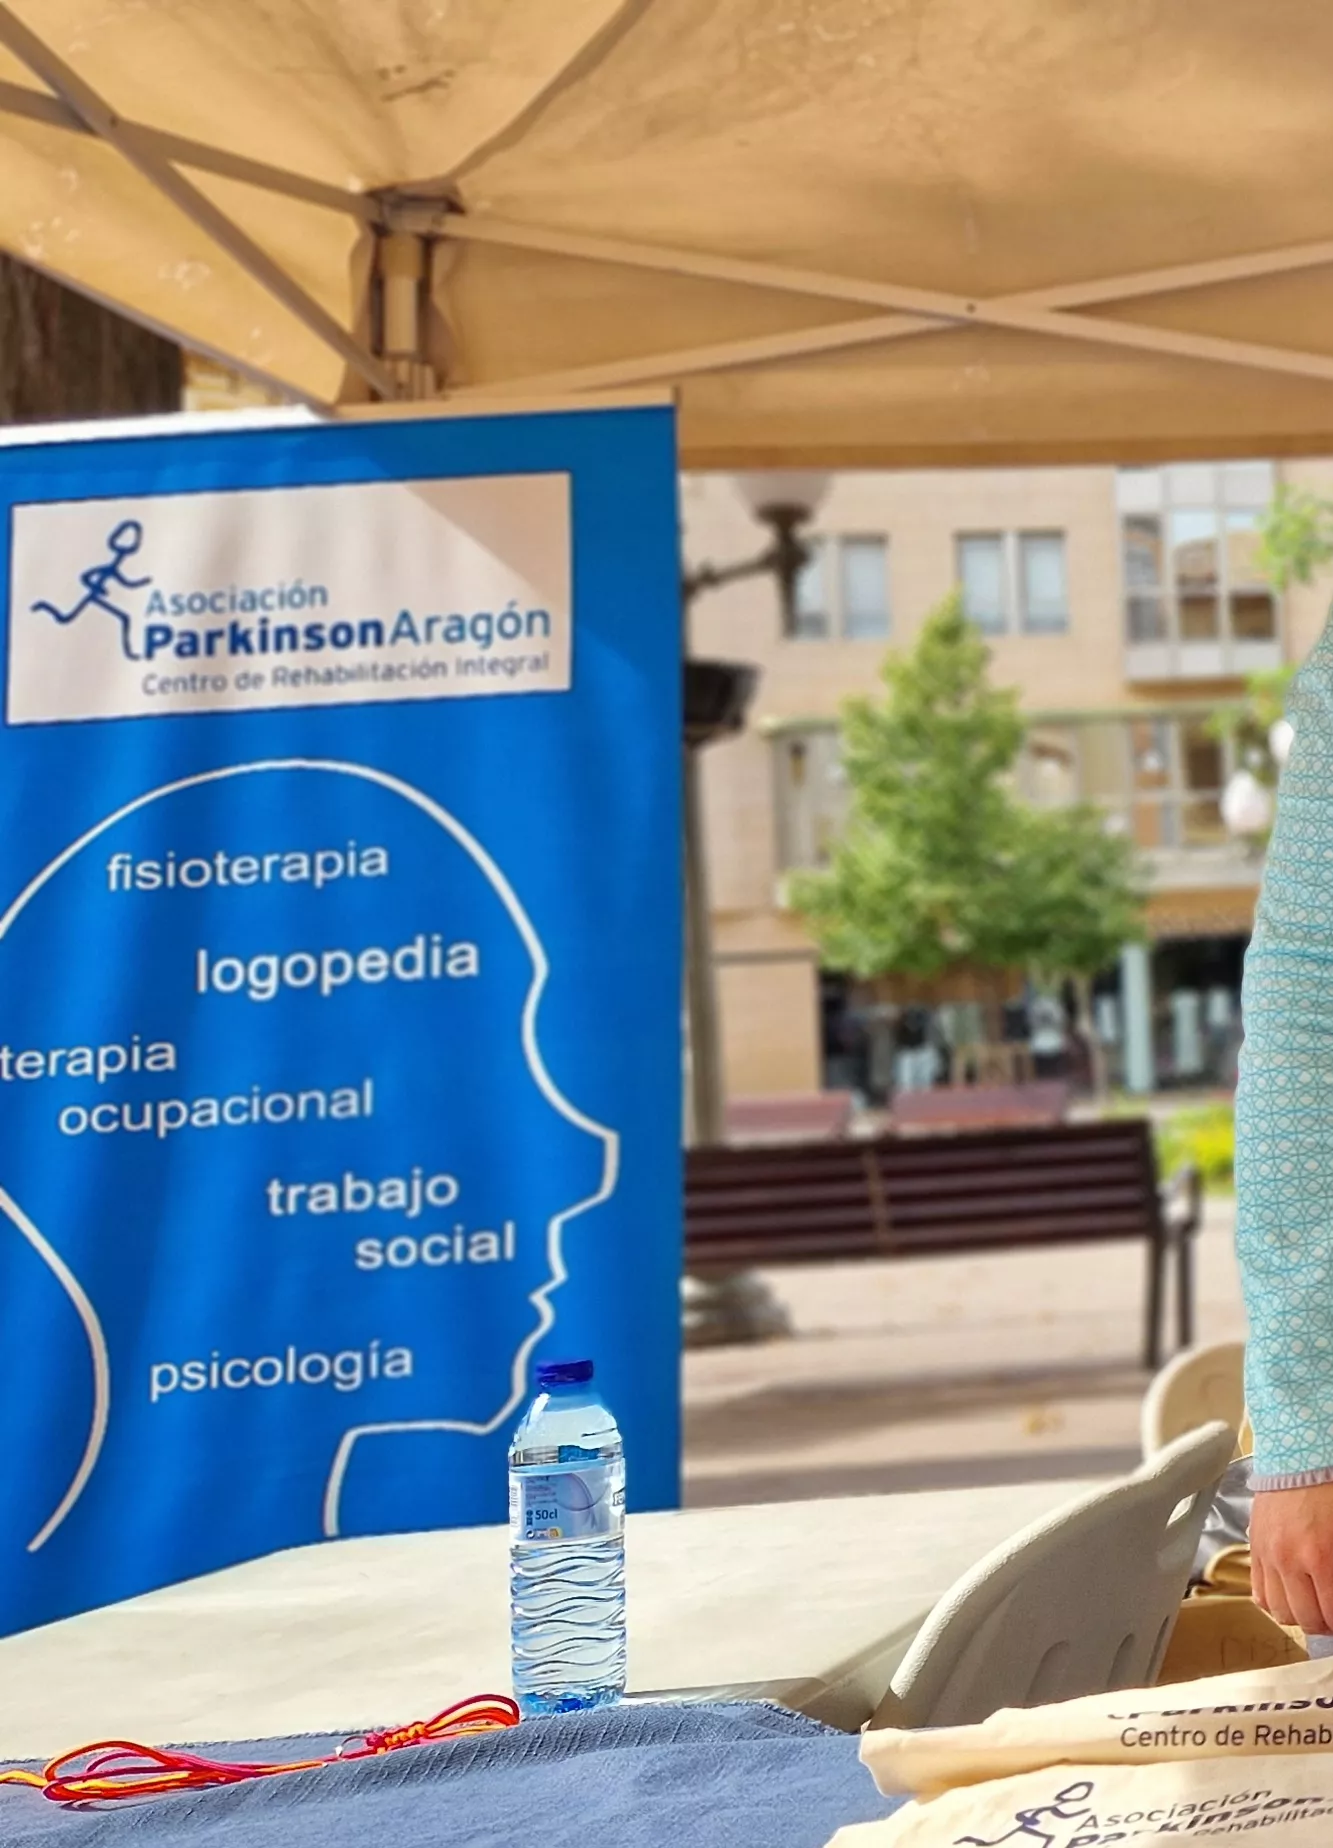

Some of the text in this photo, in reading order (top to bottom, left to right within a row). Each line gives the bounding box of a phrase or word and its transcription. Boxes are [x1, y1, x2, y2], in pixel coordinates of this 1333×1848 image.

[146, 577, 329, 617] Asociación
[141, 650, 550, 696] Centro de Rehabilitación Integral
[106, 843, 389, 892] fisioterapia
[197, 935, 480, 1002] logopedia
[0, 1036, 176, 1083] terapia
[59, 1079, 373, 1139] ocupacional
[267, 1167, 458, 1218] trabajo
[356, 1222, 515, 1270] social
[150, 1341, 413, 1402] psicología
[535, 1508, 558, 1520] 50cl
[1120, 1725, 1207, 1748] Centro
[1214, 1724, 1245, 1747] de
[1075, 1788, 1273, 1832] Asociación
